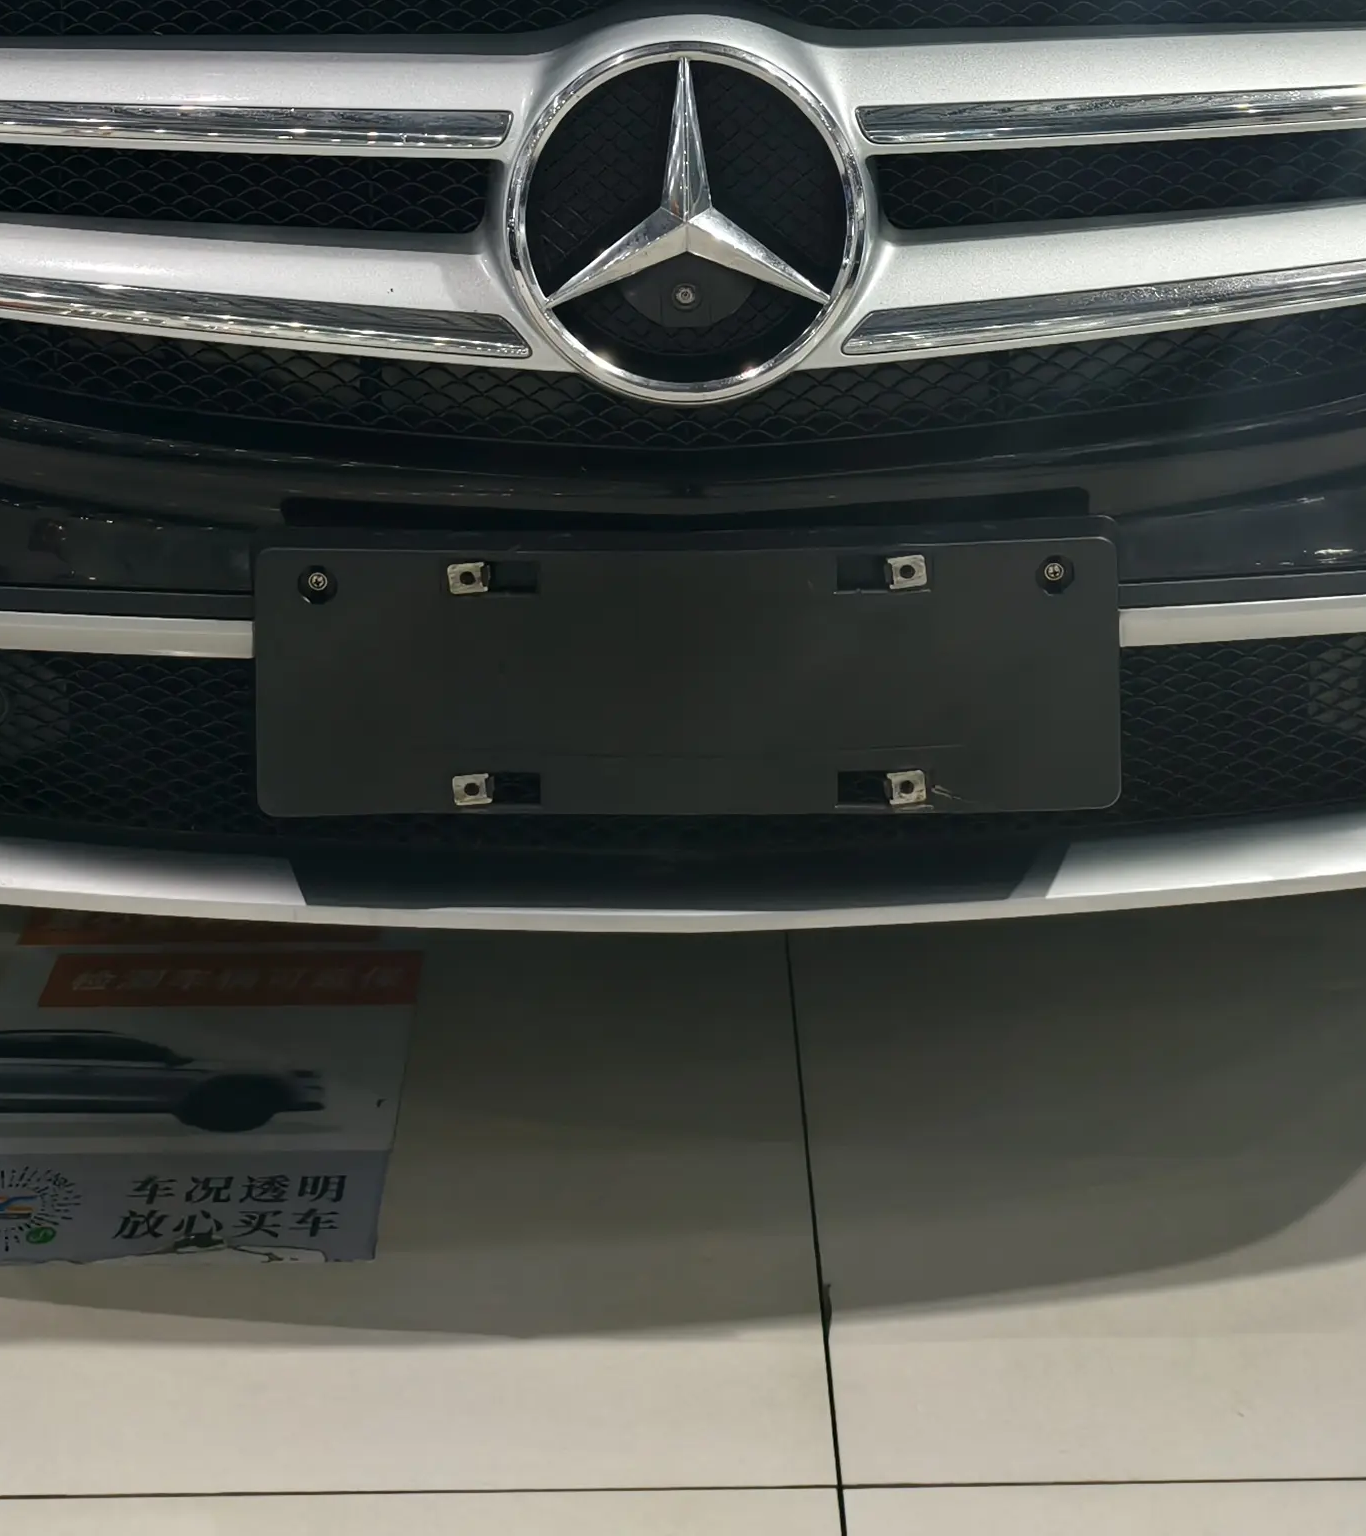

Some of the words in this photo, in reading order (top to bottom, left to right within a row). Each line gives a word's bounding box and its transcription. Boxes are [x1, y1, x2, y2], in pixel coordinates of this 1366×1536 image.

[127, 1173, 347, 1206] 车况透明
[112, 1208, 341, 1241] 放心买车
